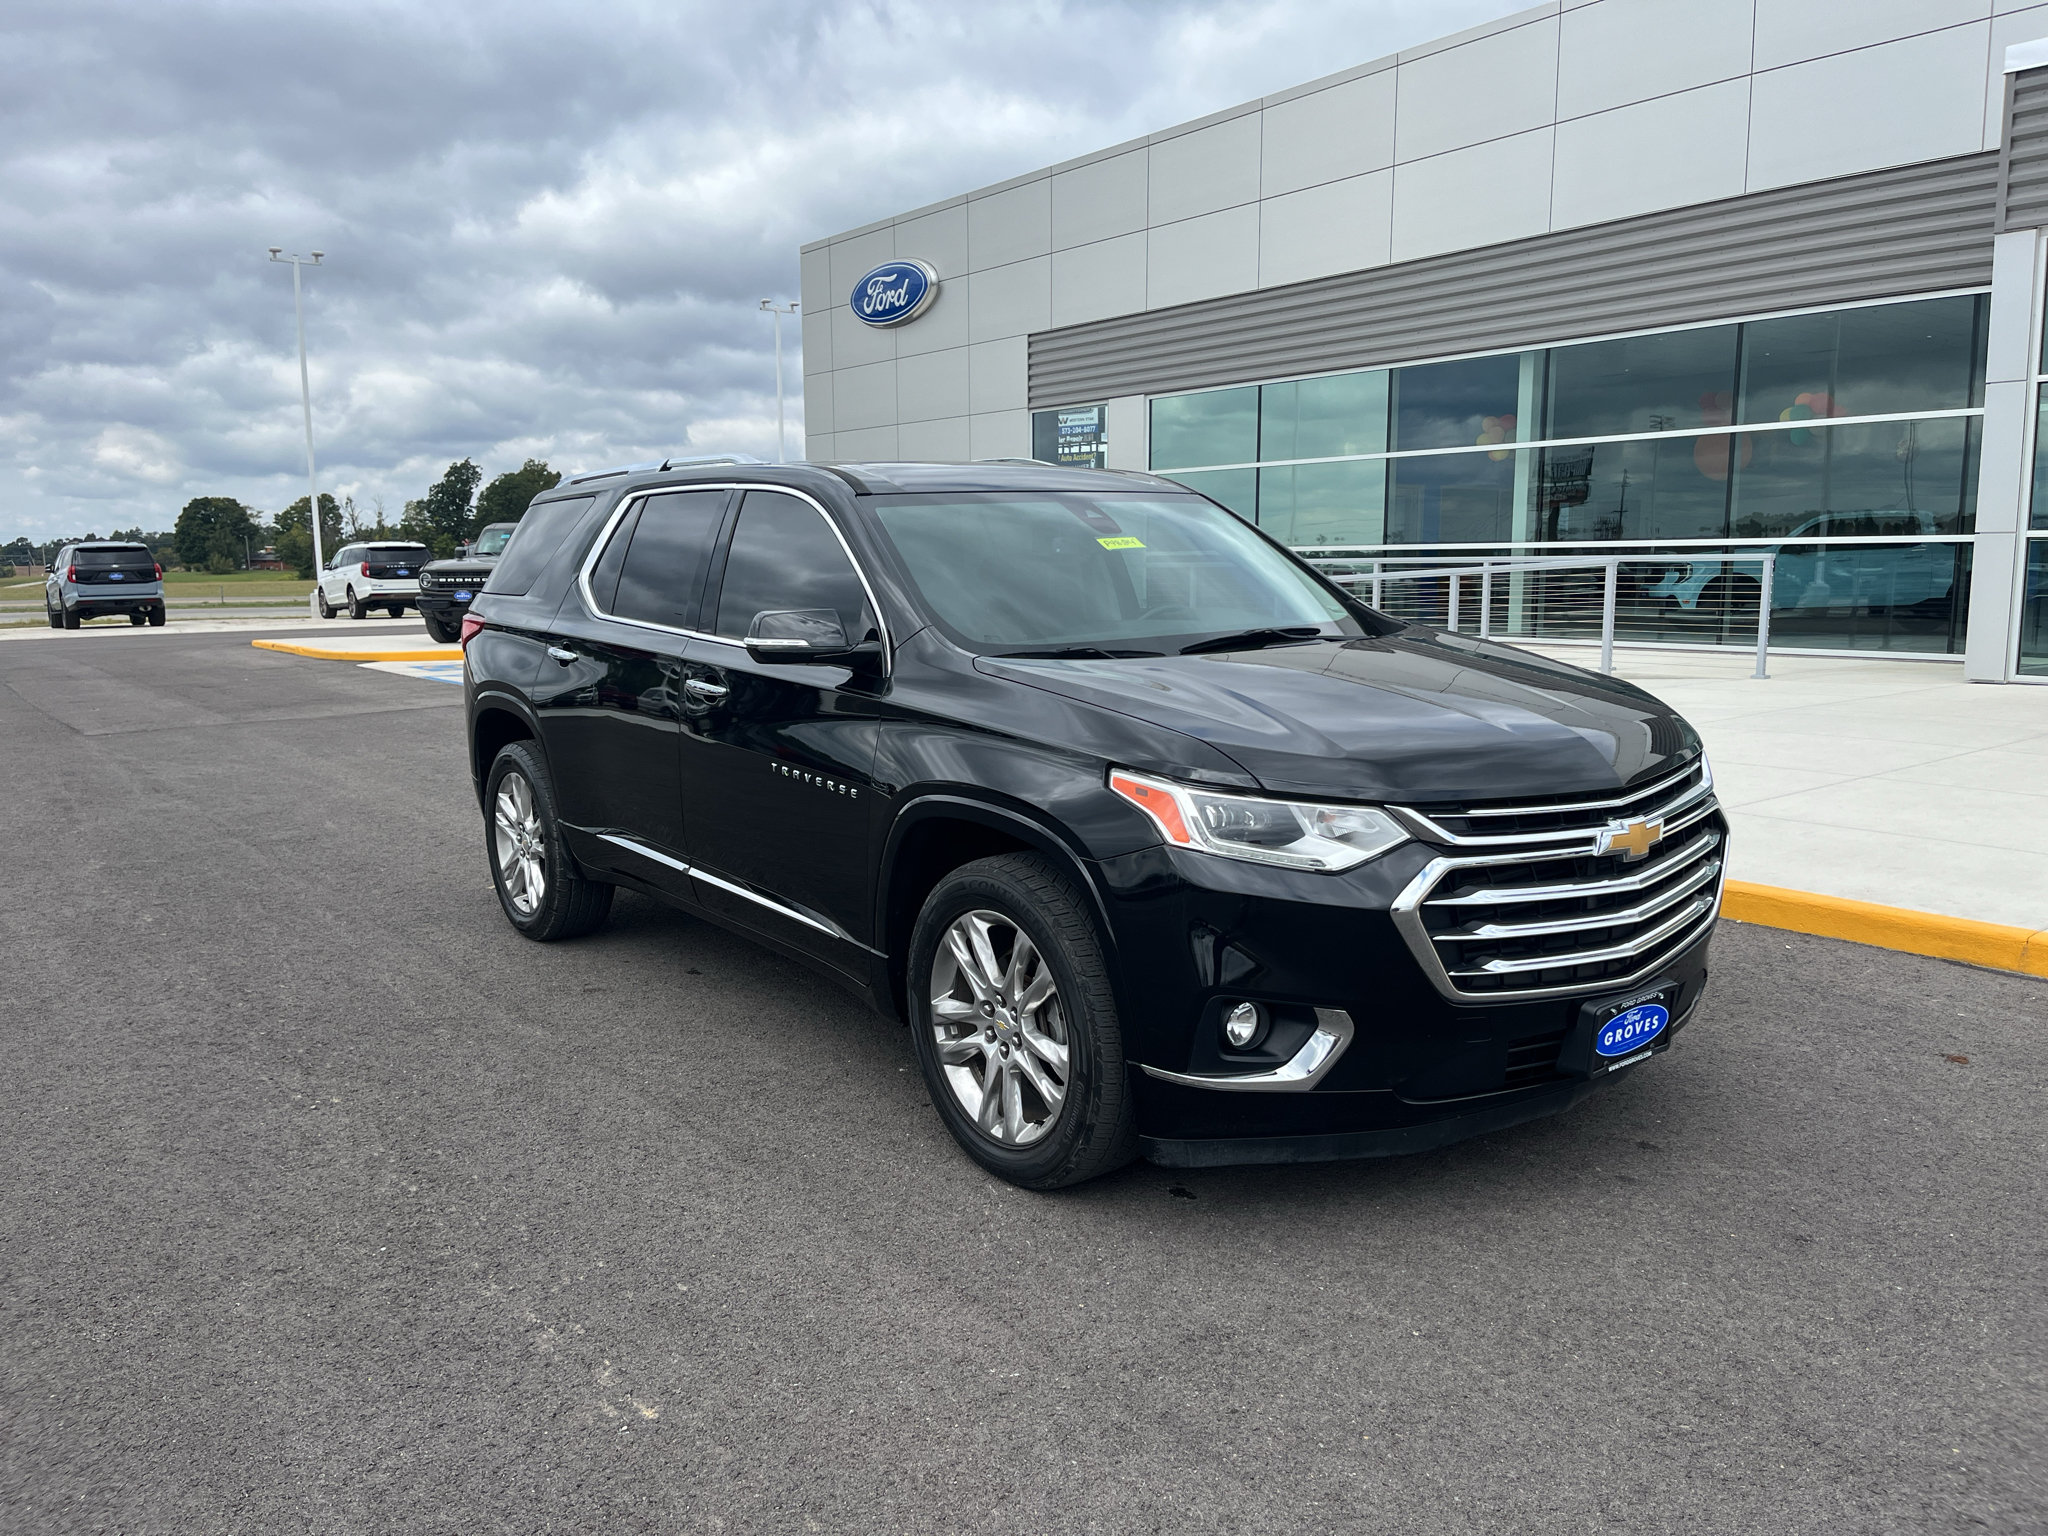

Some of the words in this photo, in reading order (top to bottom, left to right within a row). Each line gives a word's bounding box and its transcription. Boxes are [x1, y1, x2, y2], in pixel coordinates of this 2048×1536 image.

[863, 273, 909, 314] Ford
[771, 762, 858, 799] TRAVERSE
[1604, 1015, 1659, 1046] GROVES
[1624, 1010, 1643, 1025] Ford
